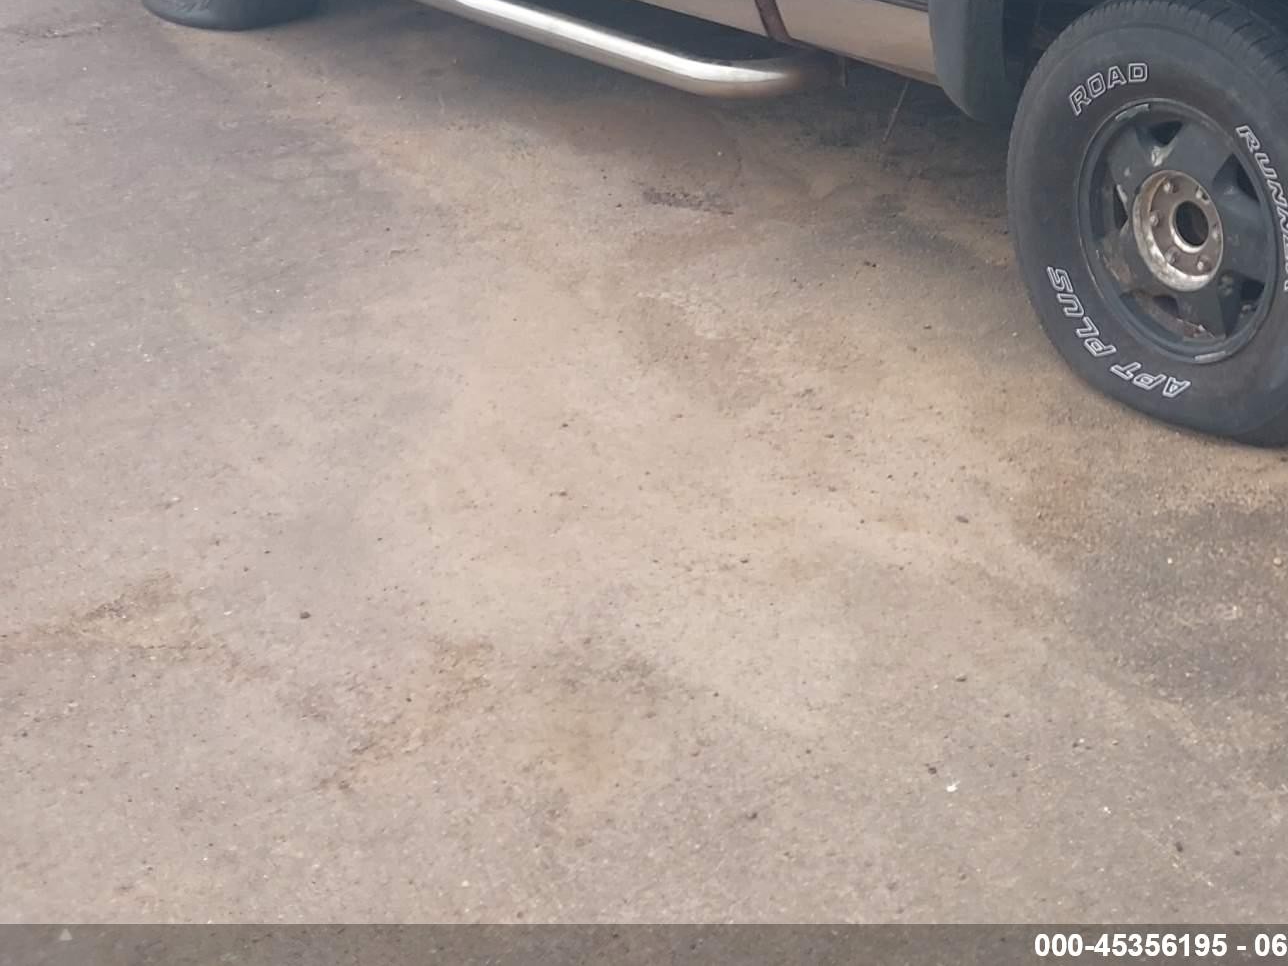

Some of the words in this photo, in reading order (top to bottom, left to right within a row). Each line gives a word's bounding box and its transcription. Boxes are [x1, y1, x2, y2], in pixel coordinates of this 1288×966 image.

[1068, 62, 1149, 116] ROAD
[1046, 266, 1117, 357] PLUS
[1109, 361, 1191, 398] APT
